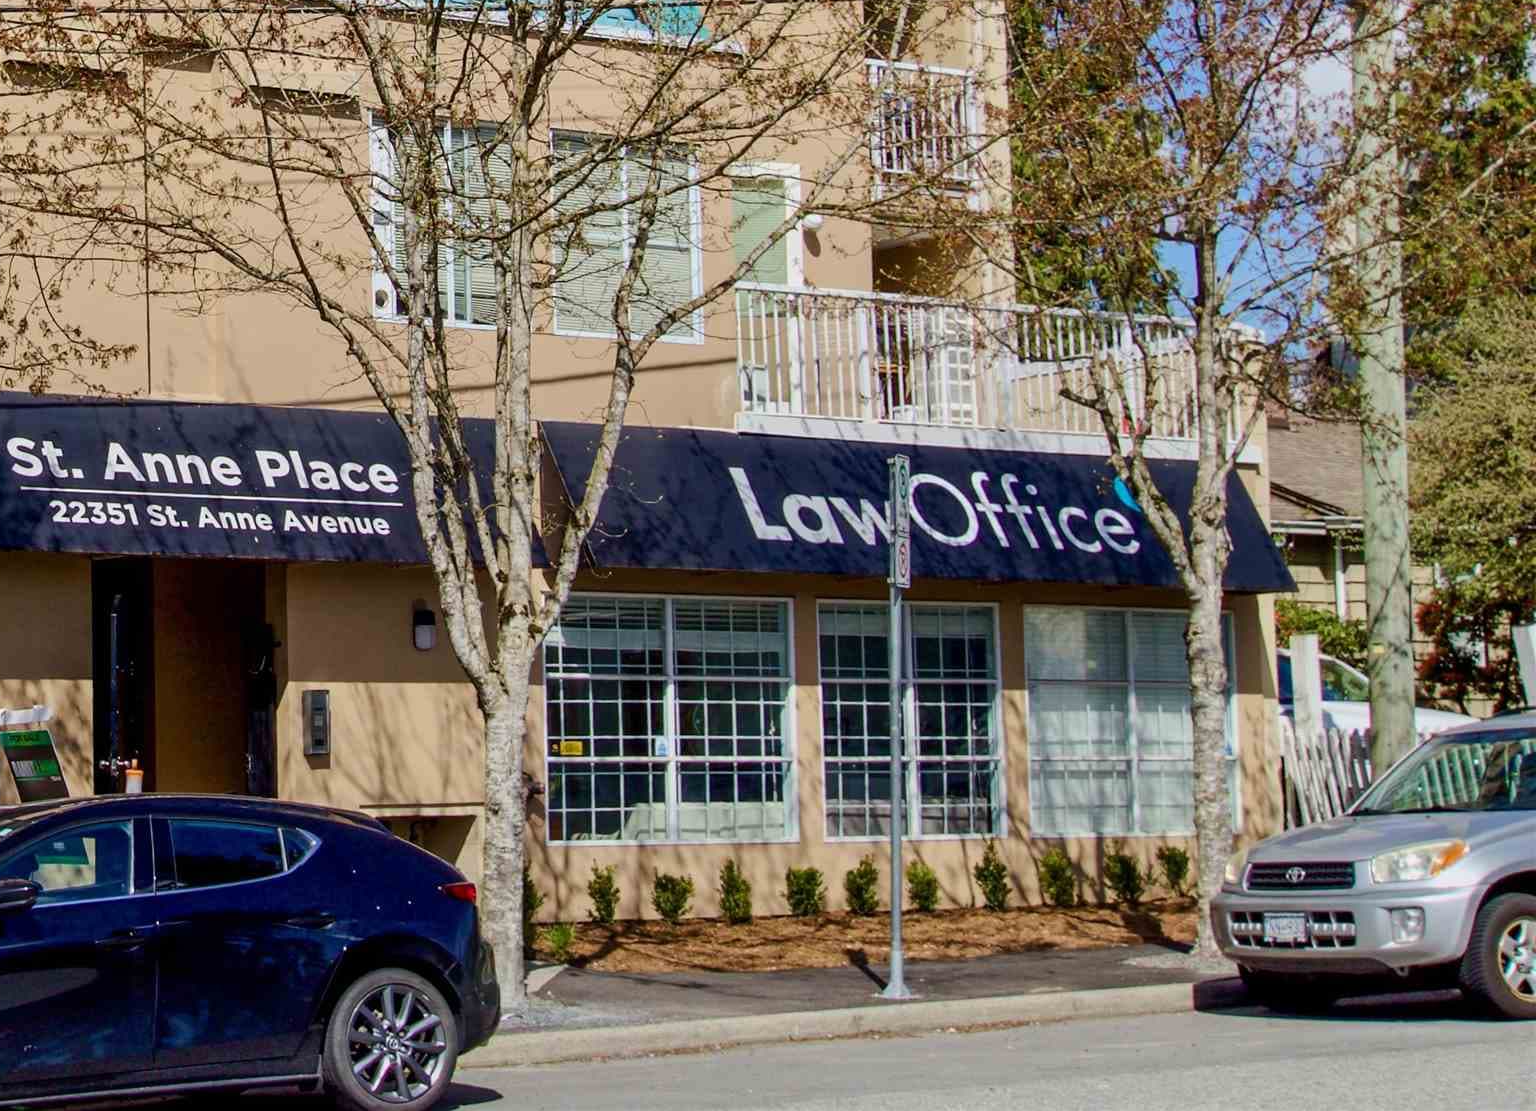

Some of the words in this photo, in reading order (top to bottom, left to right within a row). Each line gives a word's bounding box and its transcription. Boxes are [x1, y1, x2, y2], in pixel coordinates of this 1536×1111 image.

[5, 437, 84, 479] St.
[104, 442, 241, 486] Anne
[255, 450, 400, 493] Place
[48, 499, 139, 526] 22351
[146, 504, 189, 528] St.
[198, 506, 273, 531] Anne
[283, 509, 391, 536] Avenue
